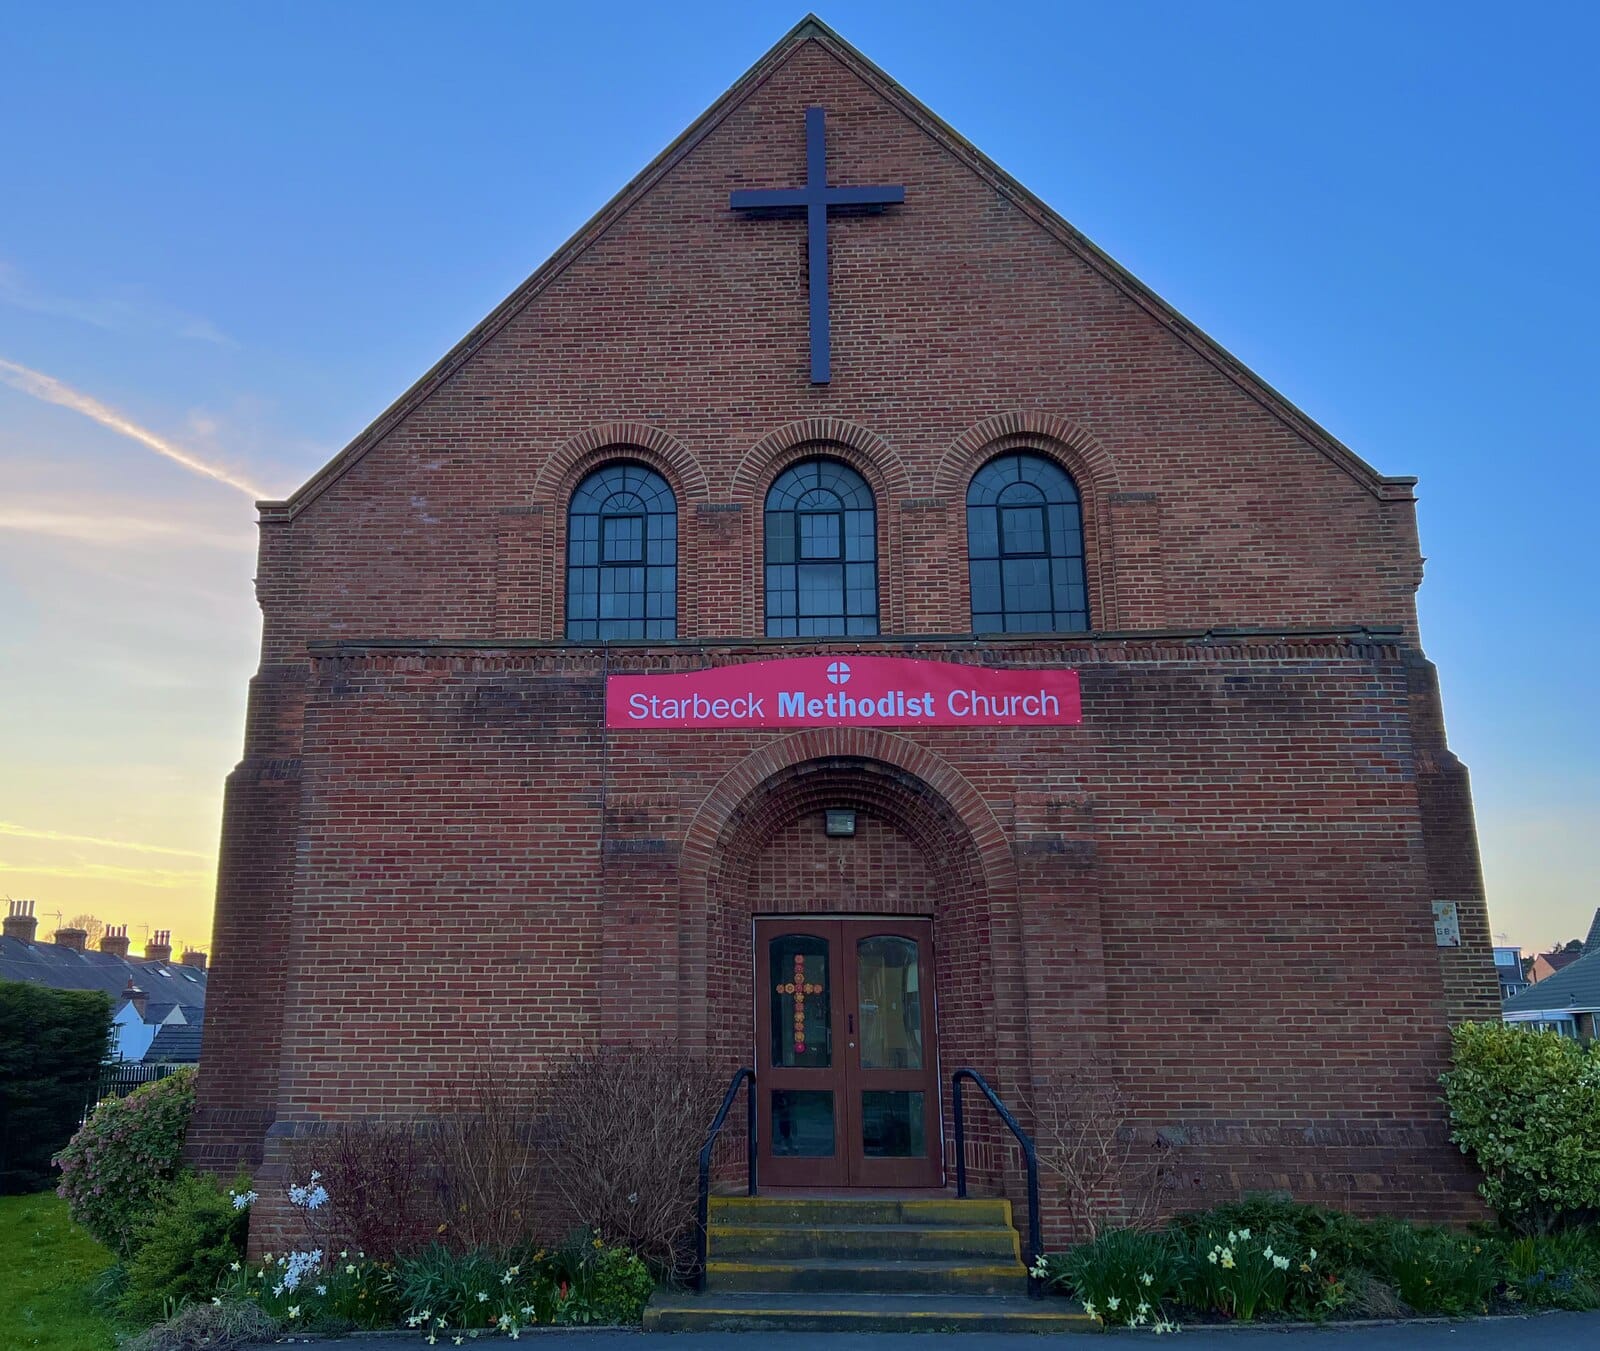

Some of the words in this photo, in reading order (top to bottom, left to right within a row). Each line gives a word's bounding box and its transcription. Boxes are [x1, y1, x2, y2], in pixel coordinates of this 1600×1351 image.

[628, 692, 765, 719] Starbeck
[778, 690, 936, 718] Methodist
[947, 689, 1059, 716] Church
